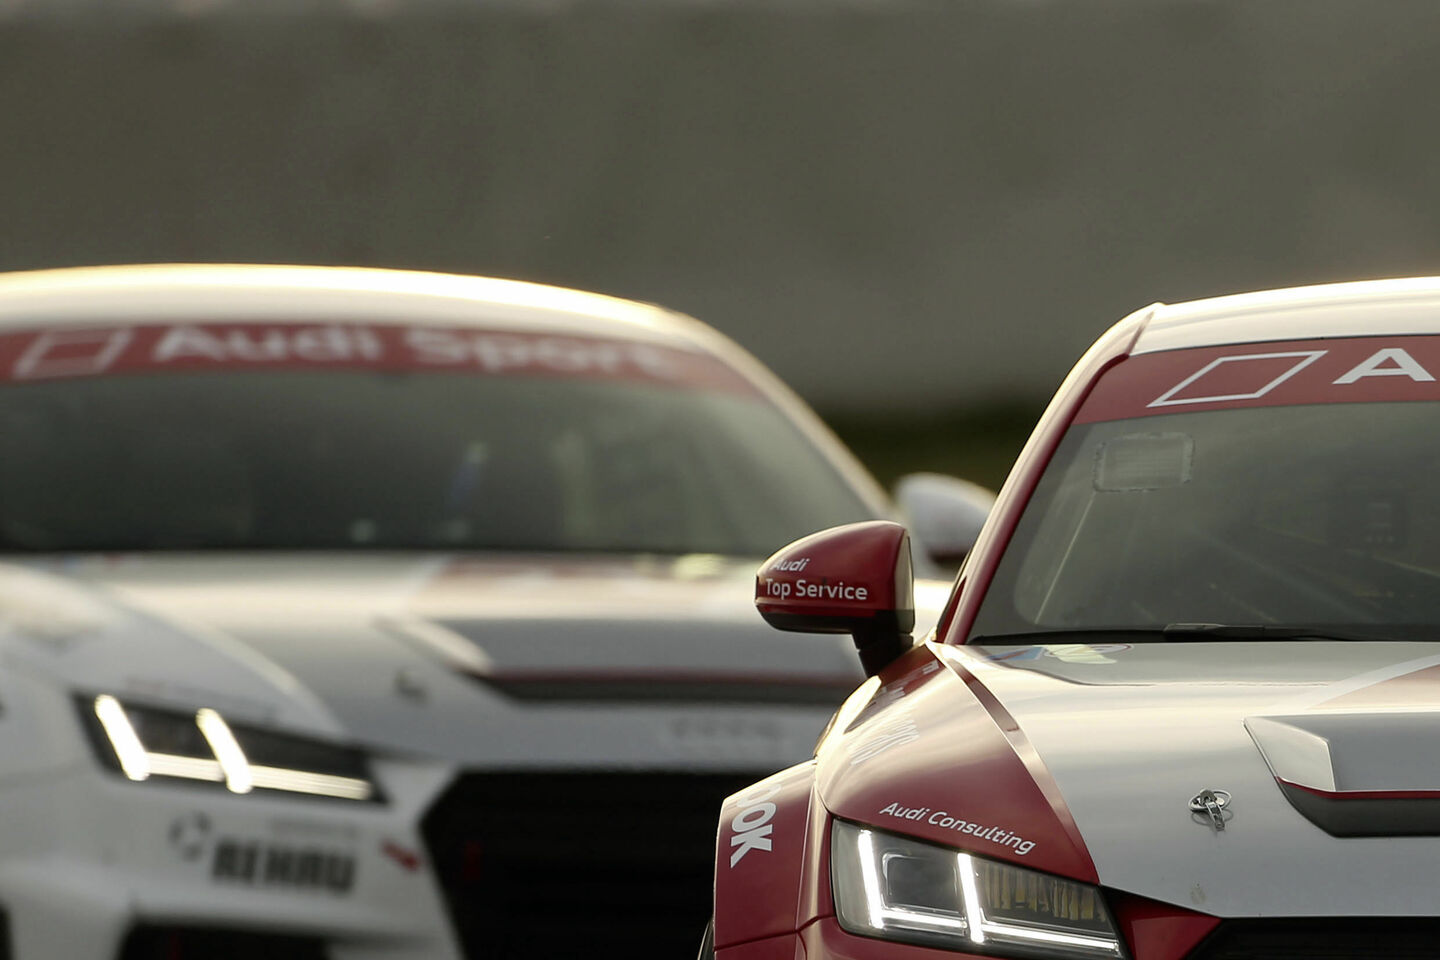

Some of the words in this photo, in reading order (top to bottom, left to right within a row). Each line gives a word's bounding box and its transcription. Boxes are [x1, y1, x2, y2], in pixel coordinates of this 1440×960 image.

[152, 325, 384, 364] Audi
[769, 558, 811, 572] Audi
[766, 578, 791, 601] Top
[795, 580, 868, 600] Service
[879, 802, 930, 821] Audi
[928, 811, 1037, 855] Consulting
